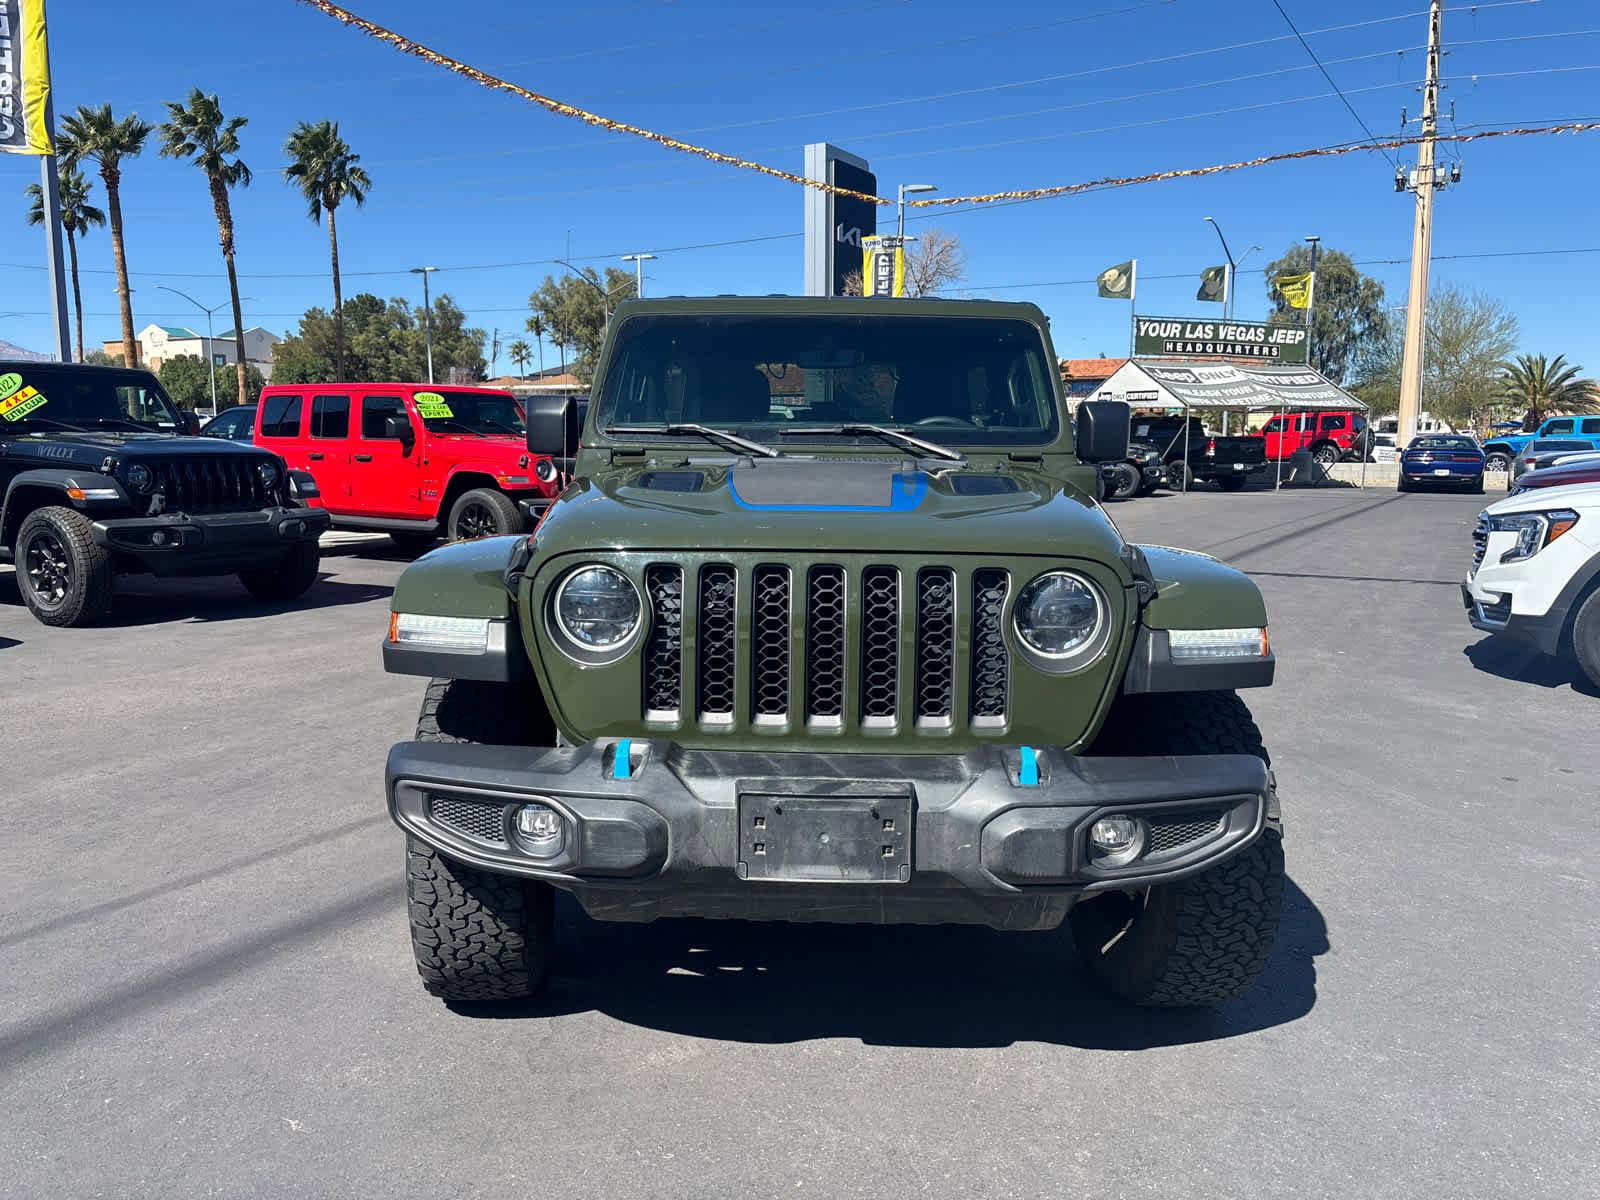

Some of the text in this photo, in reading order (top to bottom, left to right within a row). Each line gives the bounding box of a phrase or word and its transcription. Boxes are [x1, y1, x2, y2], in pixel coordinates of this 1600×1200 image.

[1139, 321, 1305, 344] YOUR LAS VEGAS JEEP
[1166, 342, 1278, 356] HEADQUARTERS
[1154, 368, 1197, 383] Jeep
[1198, 370, 1236, 380] ONLY
[1222, 385, 1254, 396] YOUR
[5, 397, 45, 420] EXTRA CLEAN
